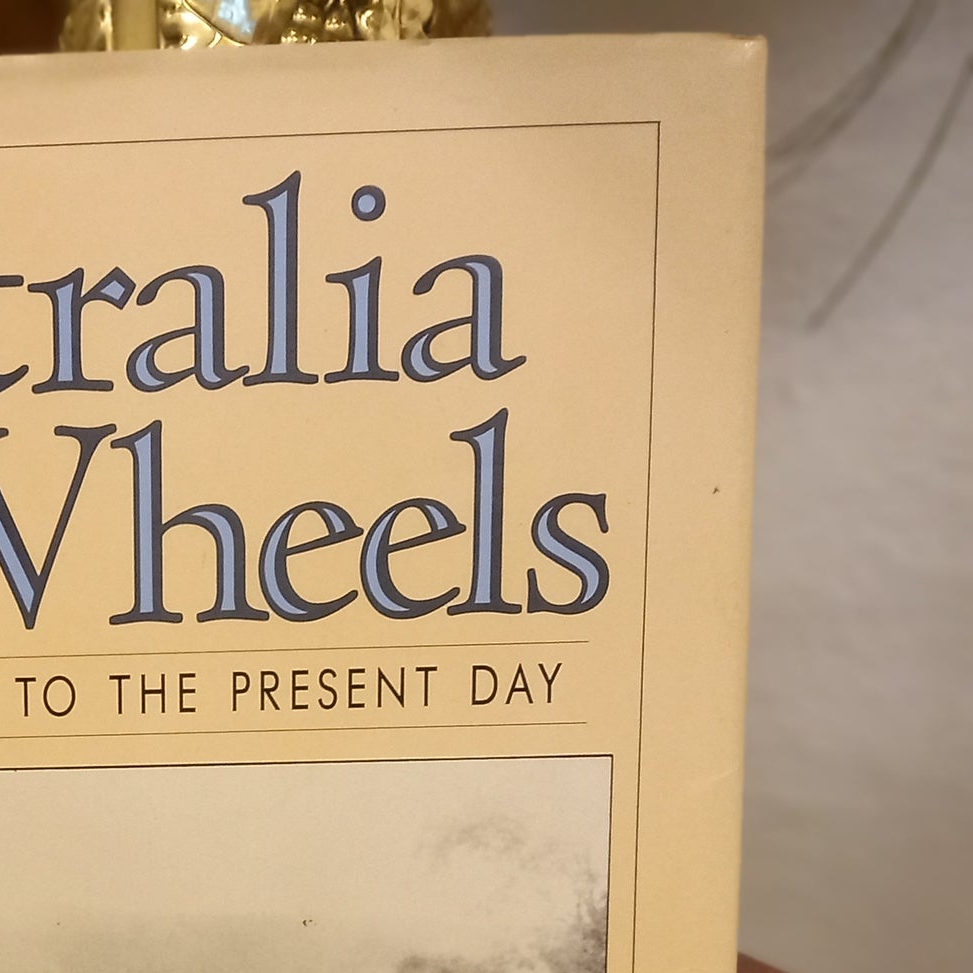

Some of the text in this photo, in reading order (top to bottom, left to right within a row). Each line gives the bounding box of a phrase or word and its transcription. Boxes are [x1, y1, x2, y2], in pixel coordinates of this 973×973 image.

[14, 674, 77, 718] TO
[108, 672, 197, 715] THE
[231, 665, 439, 712] PRESENT
[470, 662, 563, 706] DAY
